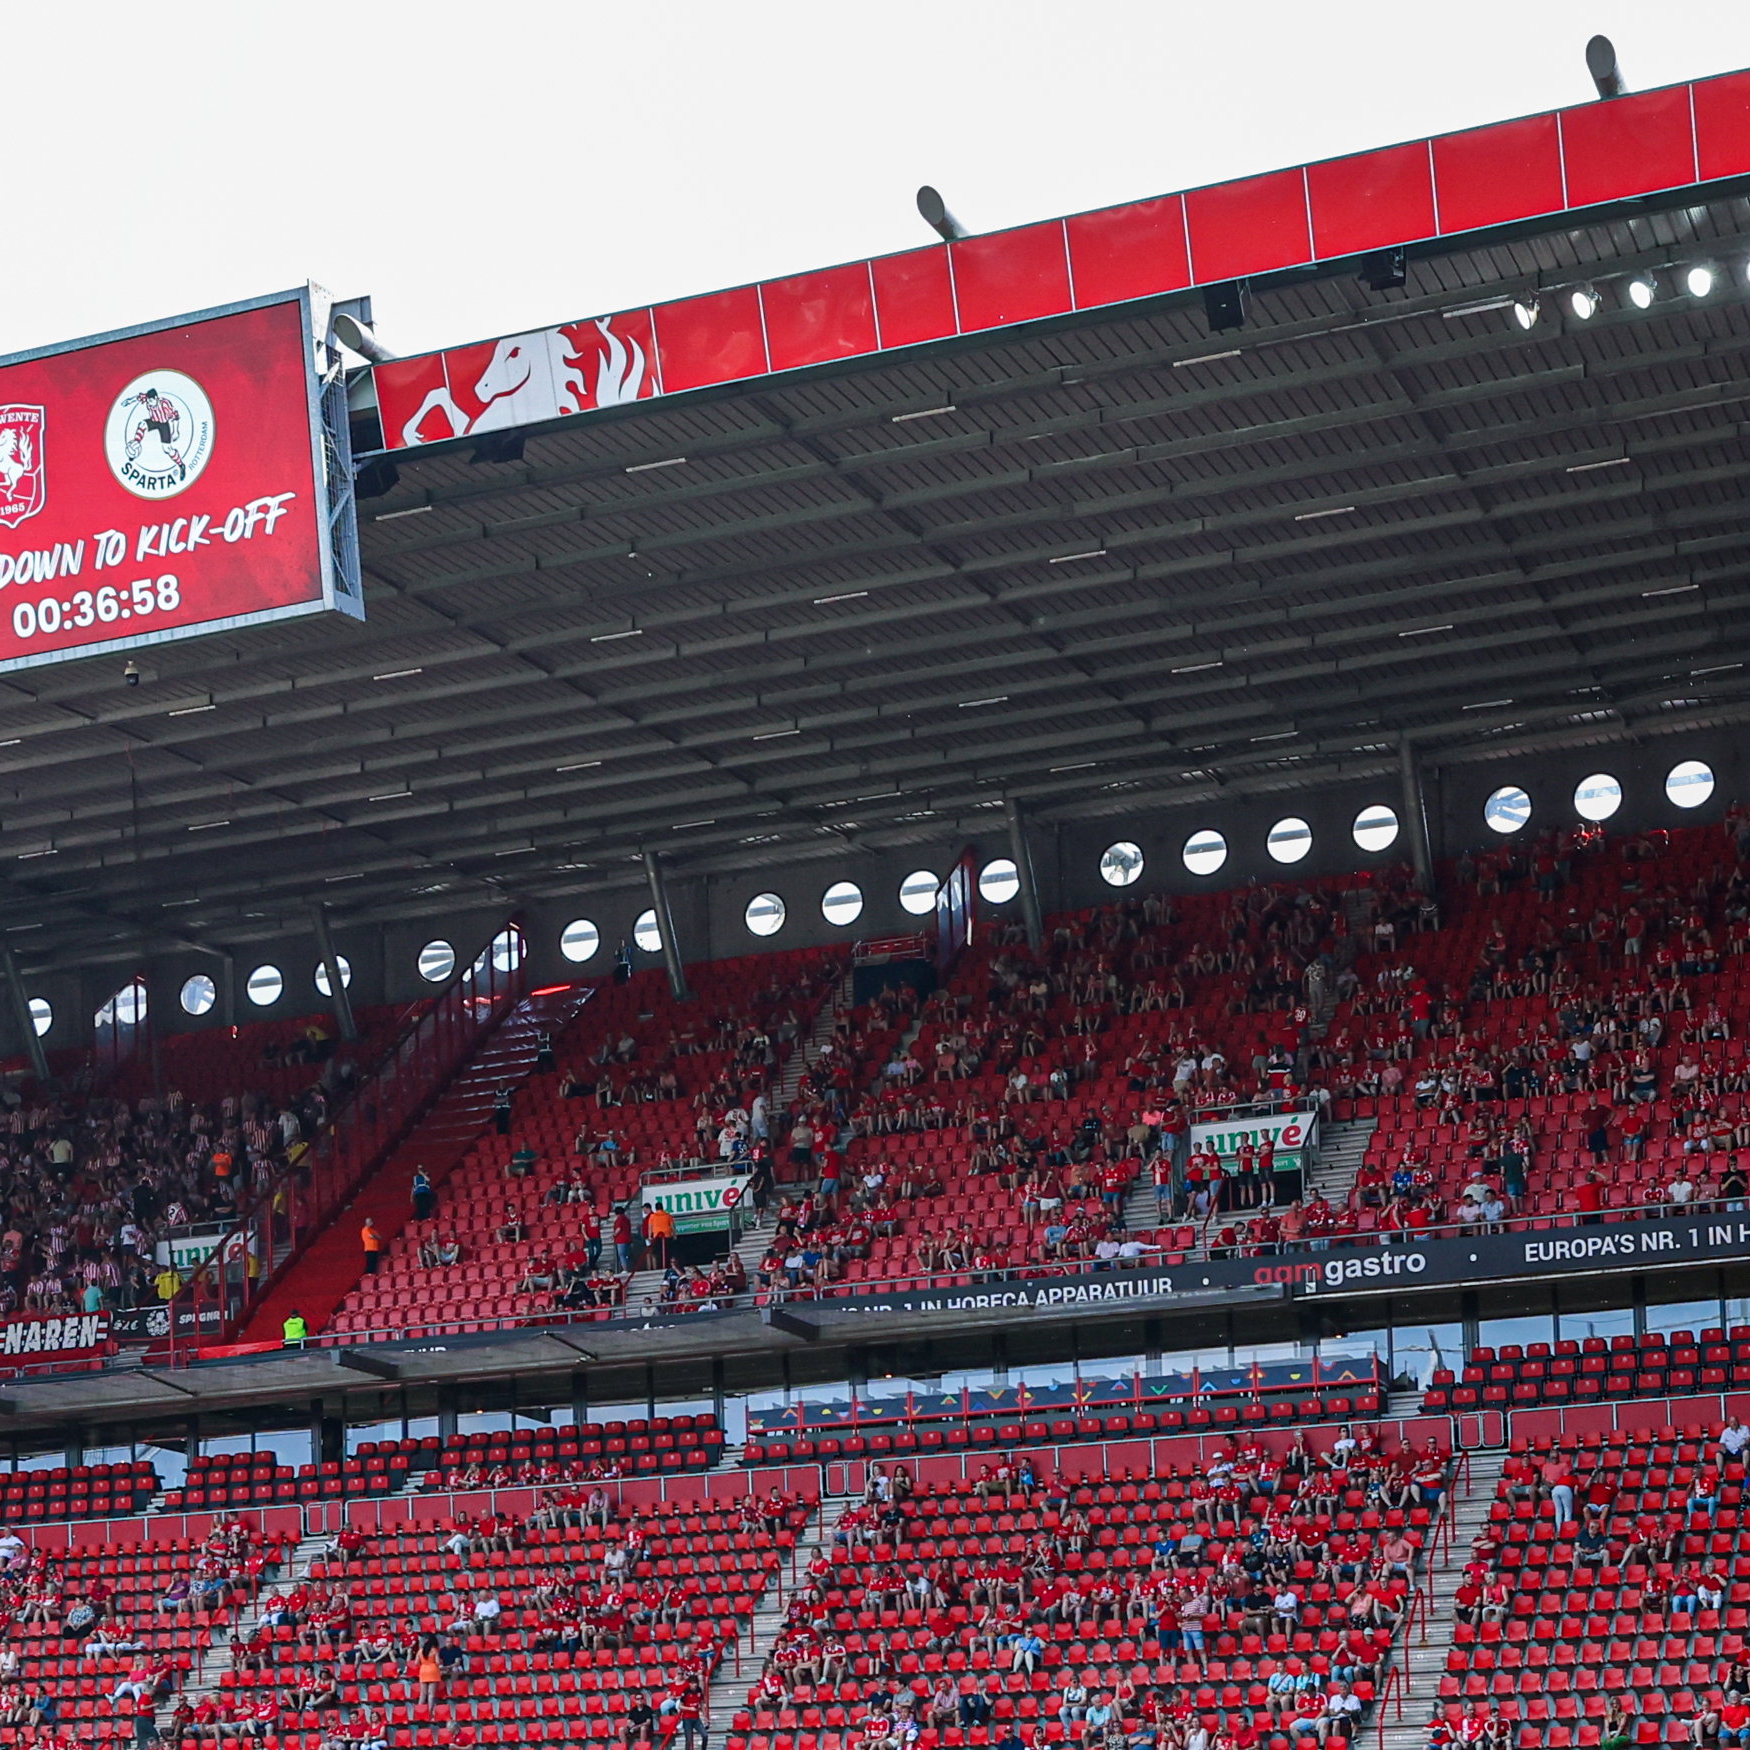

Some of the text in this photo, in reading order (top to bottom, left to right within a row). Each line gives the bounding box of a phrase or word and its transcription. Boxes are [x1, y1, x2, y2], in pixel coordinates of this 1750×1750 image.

[188, 420, 209, 471] ROTTERDAM
[120, 461, 177, 491] SPARTA
[0, 502, 26, 516] 1965
[93, 527, 128, 571] TO
[135, 492, 297, 562] KICK-OFF
[12, 574, 180, 639] 00:36:58
[1525, 1232, 1635, 1264] EUROPA'S
[1641, 1229, 1682, 1252] NR.
[1688, 1227, 1698, 1247] 1
[1708, 1224, 1732, 1246] IN
[1035, 1277, 1173, 1306] APPARATUUR
